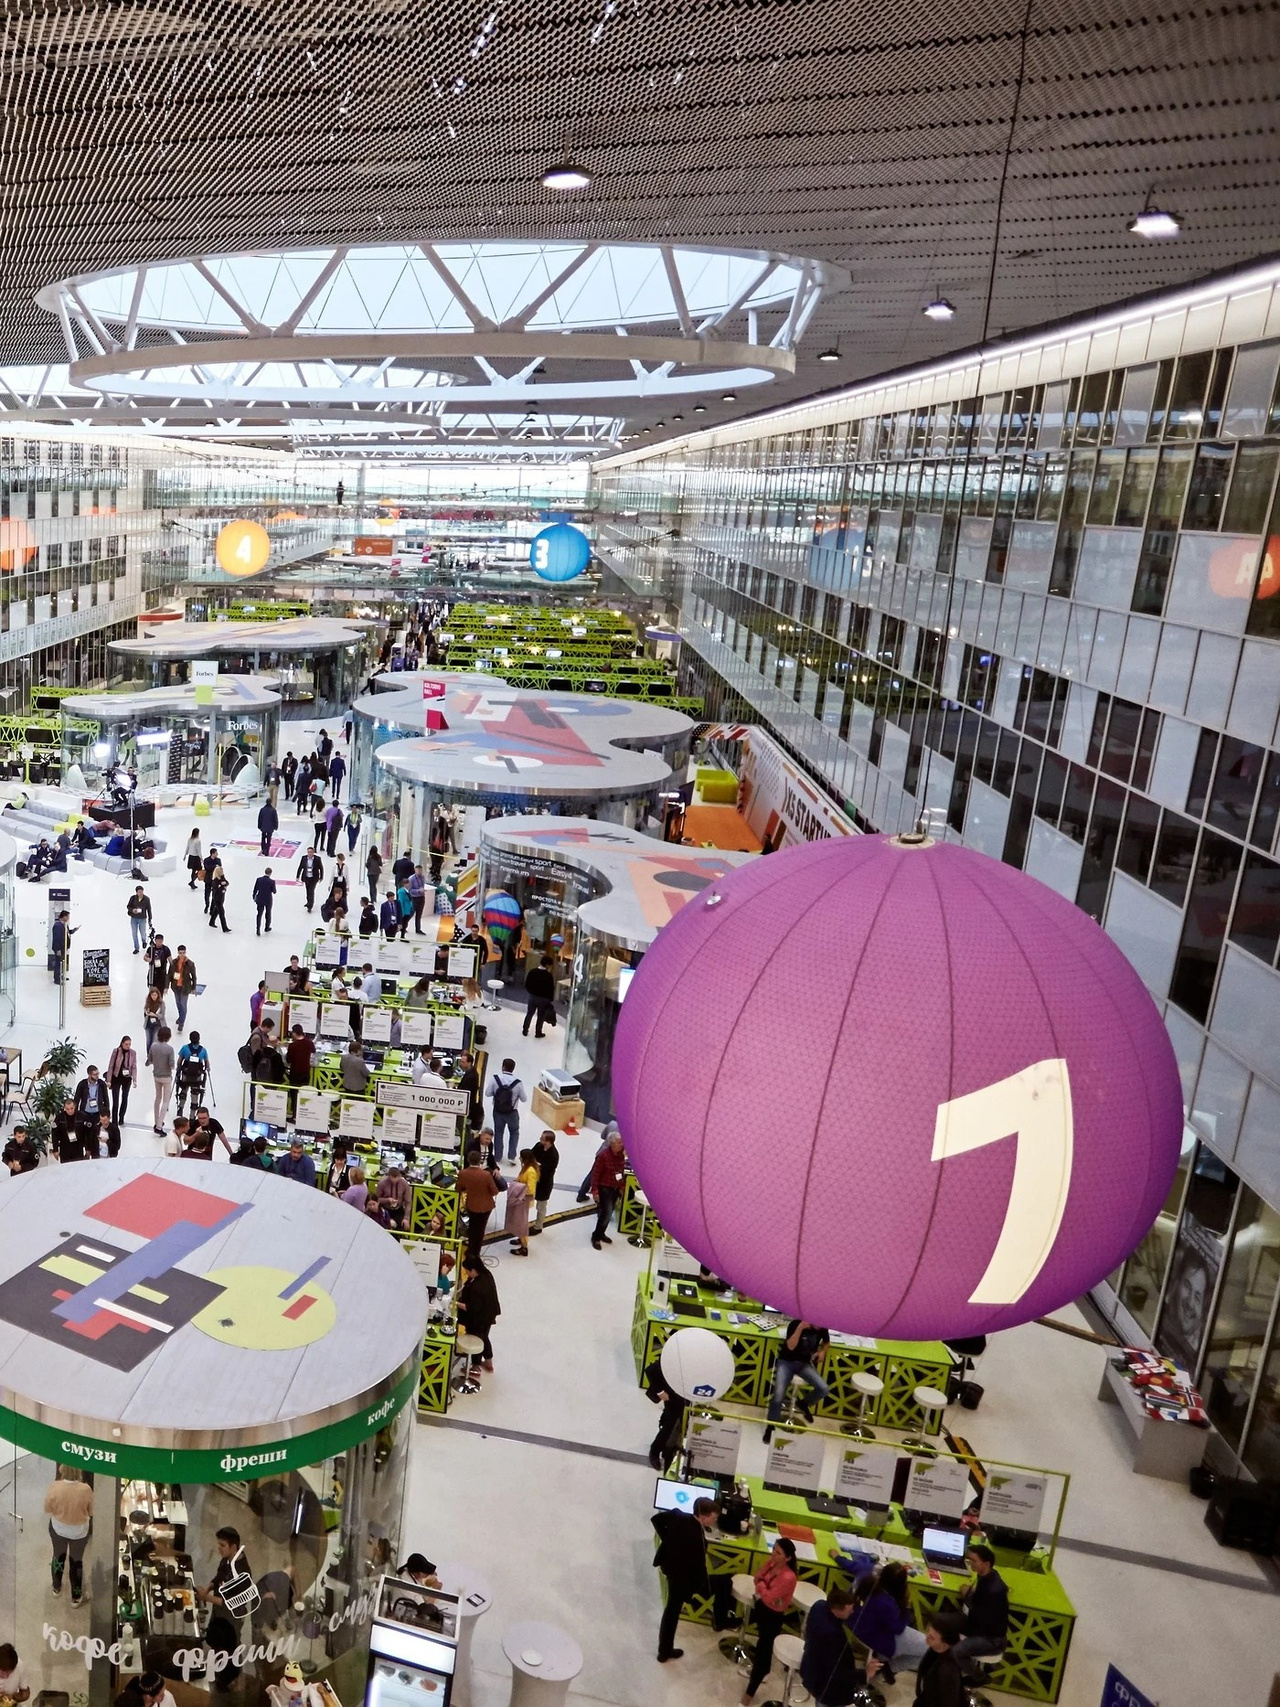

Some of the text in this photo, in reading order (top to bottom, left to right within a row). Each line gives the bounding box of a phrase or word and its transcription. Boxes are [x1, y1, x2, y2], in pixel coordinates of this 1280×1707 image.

[236, 535, 251, 562] 4
[535, 540, 549, 569] 3
[932, 1058, 1073, 1306] 1
[696, 1387, 712, 1397] 24
[367, 1396, 396, 1428] кофе
[61, 1439, 288, 1474] смузи фреши
[42, 1622, 129, 1671] кофе
[172, 1633, 303, 1684] фреши
